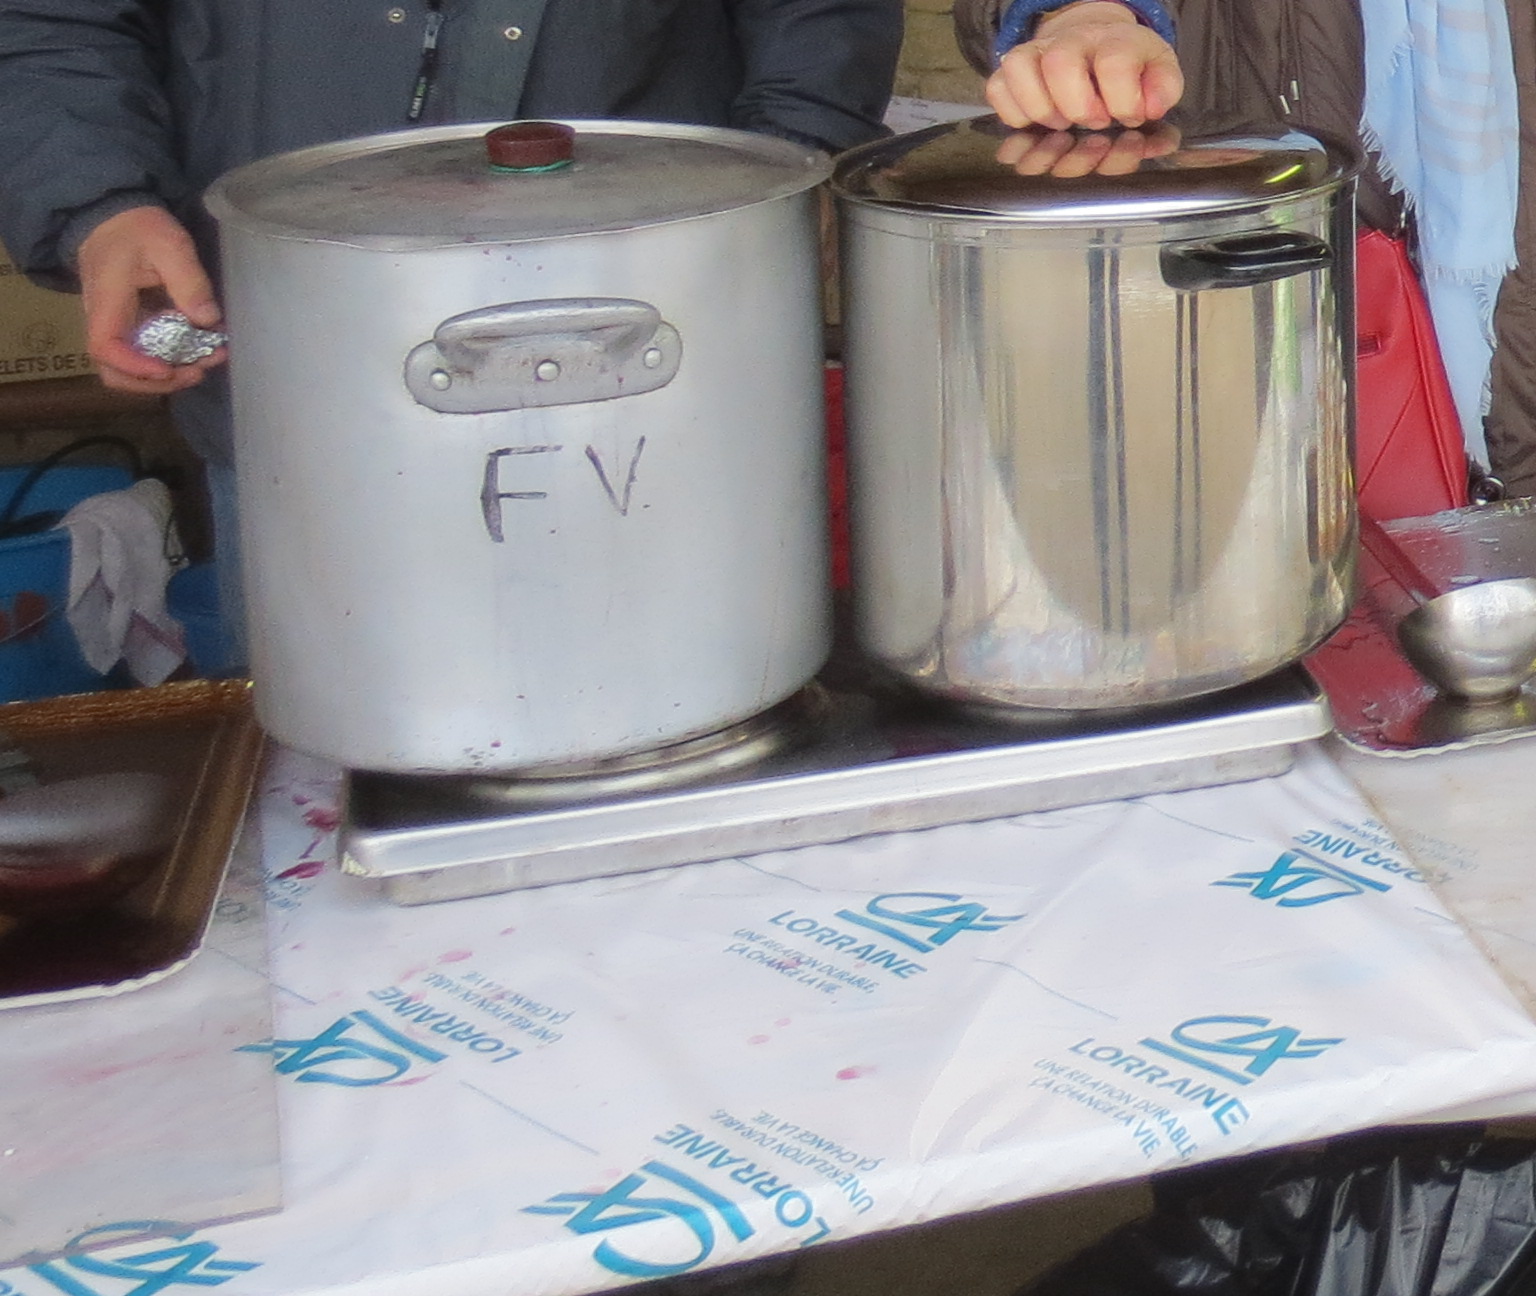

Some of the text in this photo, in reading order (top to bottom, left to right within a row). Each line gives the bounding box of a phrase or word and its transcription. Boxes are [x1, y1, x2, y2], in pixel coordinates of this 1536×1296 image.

[747, 950, 801, 981] CHANGE
[759, 937, 822, 969] RELATION
[768, 909, 928, 980] LORRAINE
[367, 985, 524, 1064] LORRAINE
[1033, 1057, 1064, 1077] UNE
[1064, 1068, 1133, 1105] RELATION
[1052, 1082, 1120, 1115] CHANGE
[1114, 1108, 1133, 1127] LA
[1068, 1037, 1251, 1136] LORRAINE
[777, 1139, 845, 1186] RELATION
[794, 1127, 857, 1168] CHANGE
[653, 1122, 832, 1247] LORRAINE
[838, 1172, 875, 1216] UNE
